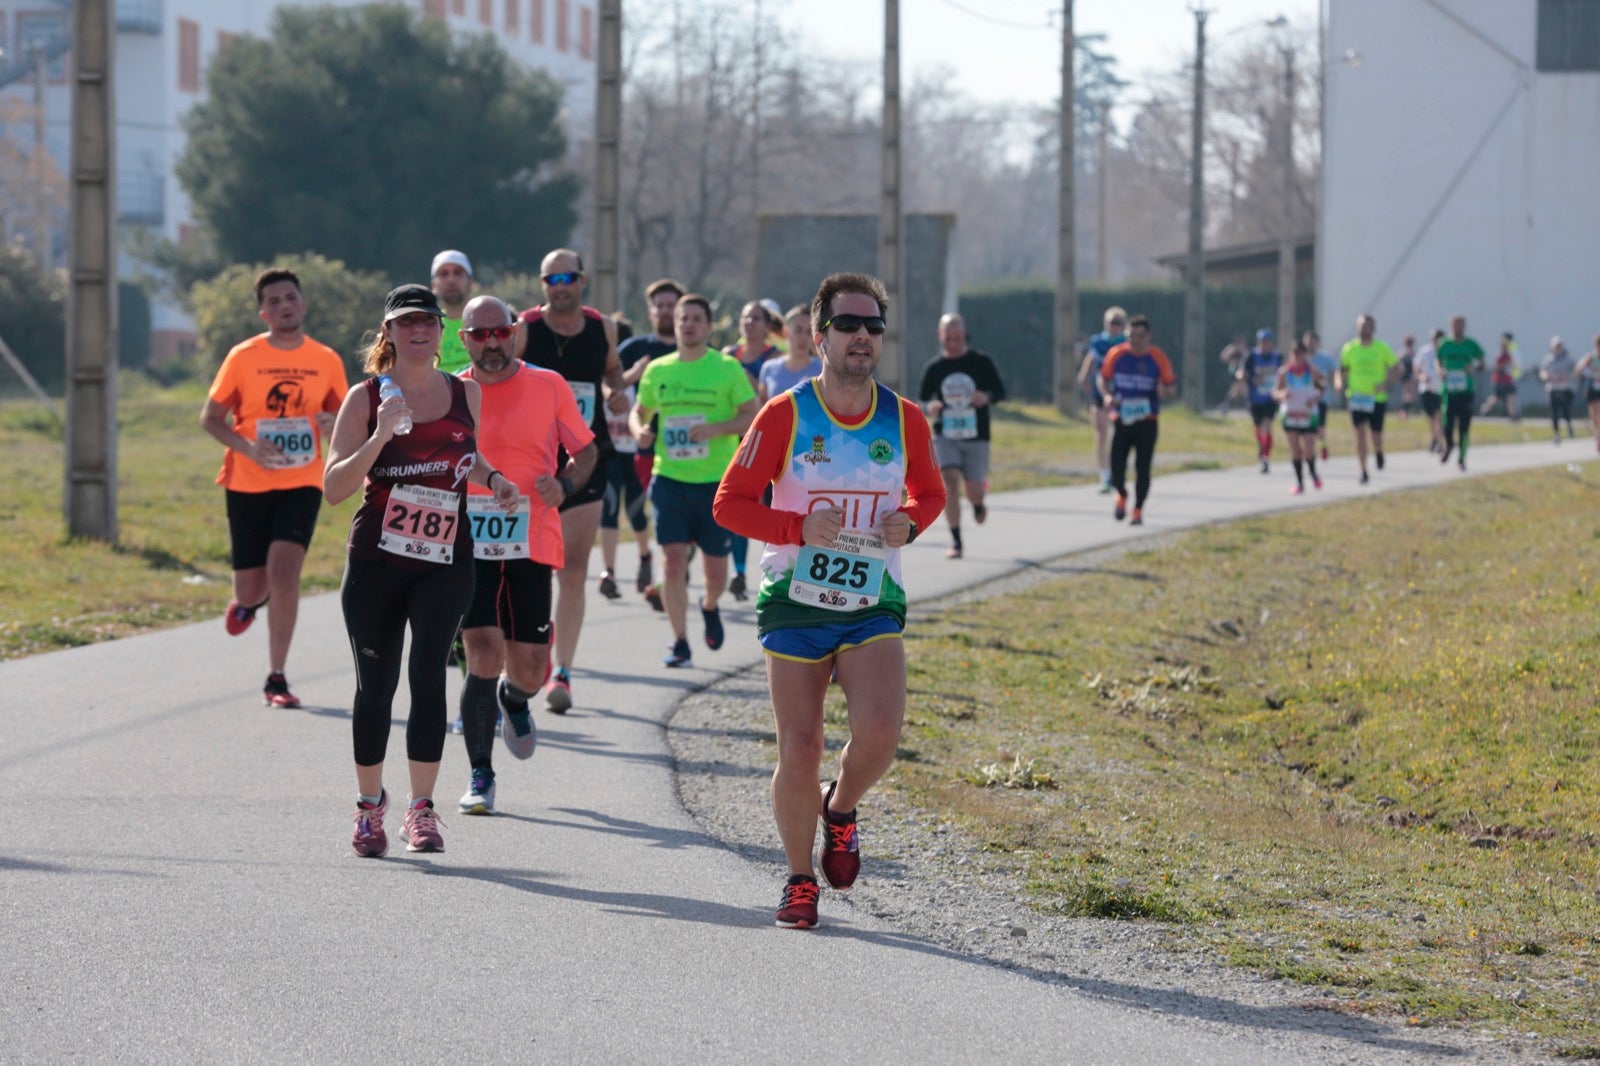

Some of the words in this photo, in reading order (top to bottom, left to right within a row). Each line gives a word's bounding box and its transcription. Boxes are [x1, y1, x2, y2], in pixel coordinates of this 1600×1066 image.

[265, 433, 313, 452] 060
[666, 429, 698, 447] 30
[388, 504, 456, 540] 2187
[473, 515, 519, 539] 707
[839, 534, 859, 545] PREMIO
[859, 538, 865, 546] DE
[809, 552, 870, 589] 825
